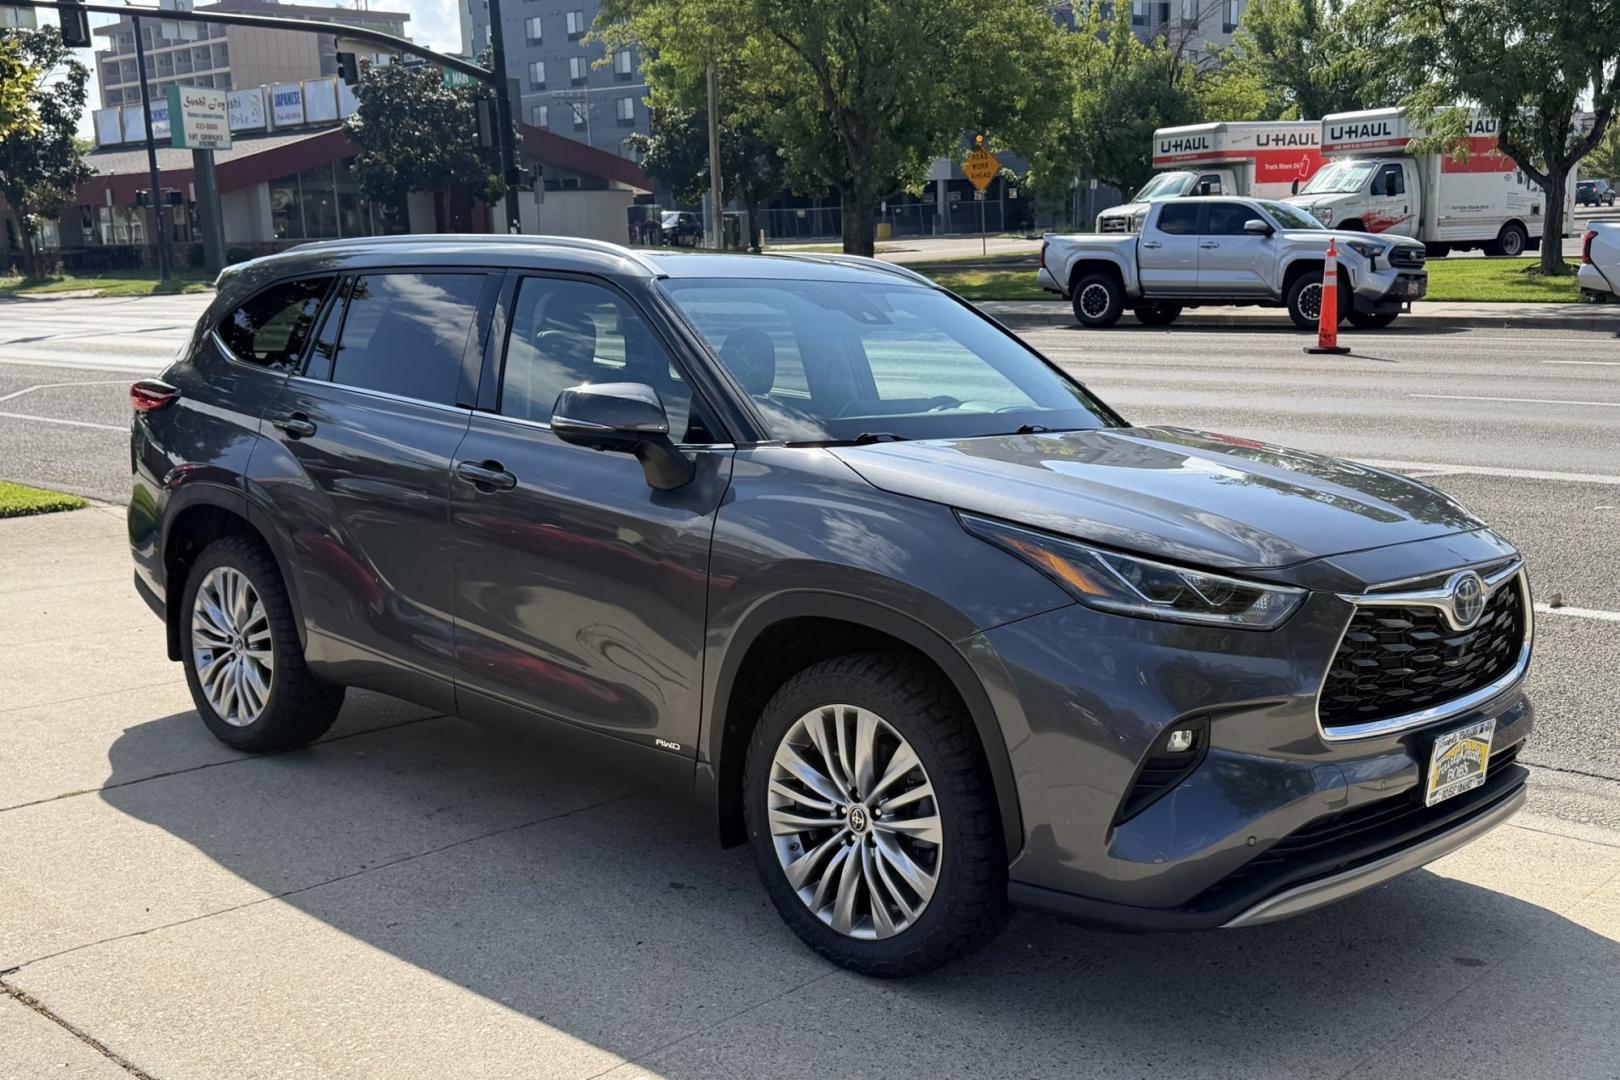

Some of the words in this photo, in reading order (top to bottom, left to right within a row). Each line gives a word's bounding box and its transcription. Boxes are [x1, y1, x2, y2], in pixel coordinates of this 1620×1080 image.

[274, 90, 300, 107] JAPANESE
[1330, 121, 1392, 141] U-HAUL
[1160, 136, 1210, 154] U-HAUL
[1256, 132, 1320, 147] U-HAUL
[972, 162, 989, 170] WORK
[971, 171, 992, 179] AHEAD
[655, 738, 681, 751] AWD
